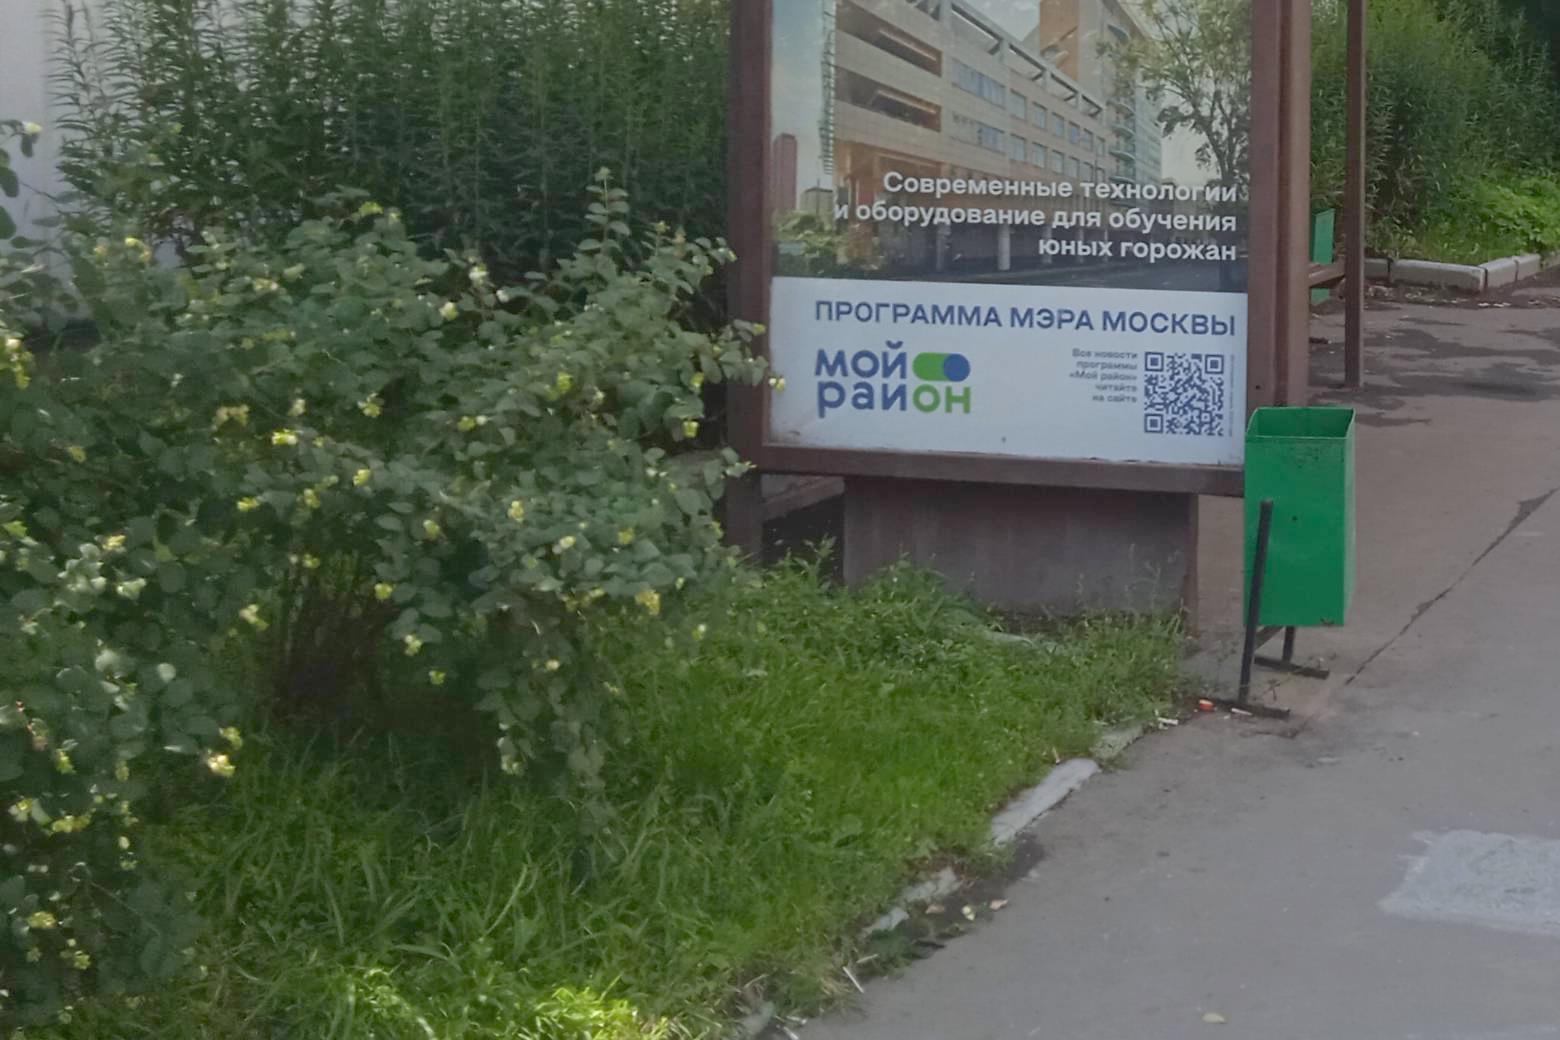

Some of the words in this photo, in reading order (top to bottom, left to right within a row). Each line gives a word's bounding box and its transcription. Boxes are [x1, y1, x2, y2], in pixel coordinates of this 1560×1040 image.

[883, 171, 1073, 198] Современные
[1081, 179, 1237, 203] технологии
[833, 206, 848, 220] и
[856, 203, 1045, 227] оборудование
[1052, 212, 1101, 229] для
[1109, 209, 1237, 233] обучения
[1038, 239, 1112, 257] юных
[1120, 243, 1237, 263] горожан
[815, 301, 1002, 328] ПРОГРАММА
[1010, 308, 1094, 331] МЭРА
[1102, 310, 1236, 336] МОСКВЫ
[1094, 350, 1138, 359] новости
[1076, 361, 1138, 371] программы
[1095, 383, 1138, 392] читайте
[1107, 393, 1138, 403] сайте
